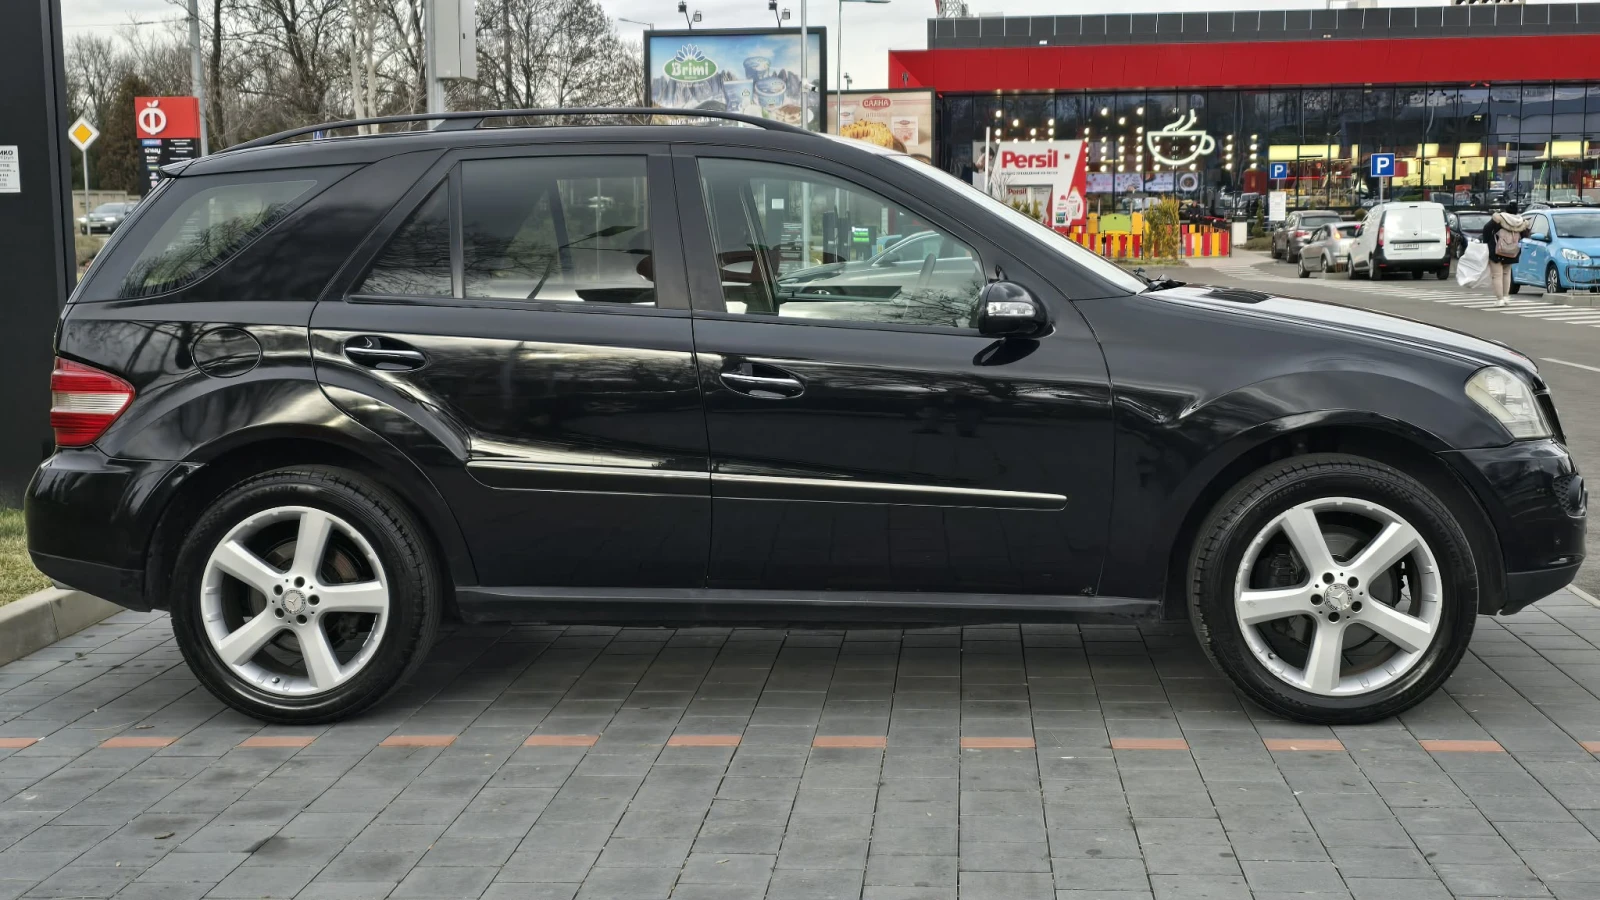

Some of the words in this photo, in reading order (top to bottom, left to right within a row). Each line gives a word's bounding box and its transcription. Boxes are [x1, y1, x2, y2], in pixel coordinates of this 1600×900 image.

[671, 62, 709, 76] Brimi
[1001, 148, 1058, 168] Persil
[1376, 157, 1390, 174] P
[1274, 164, 1284, 177] P
